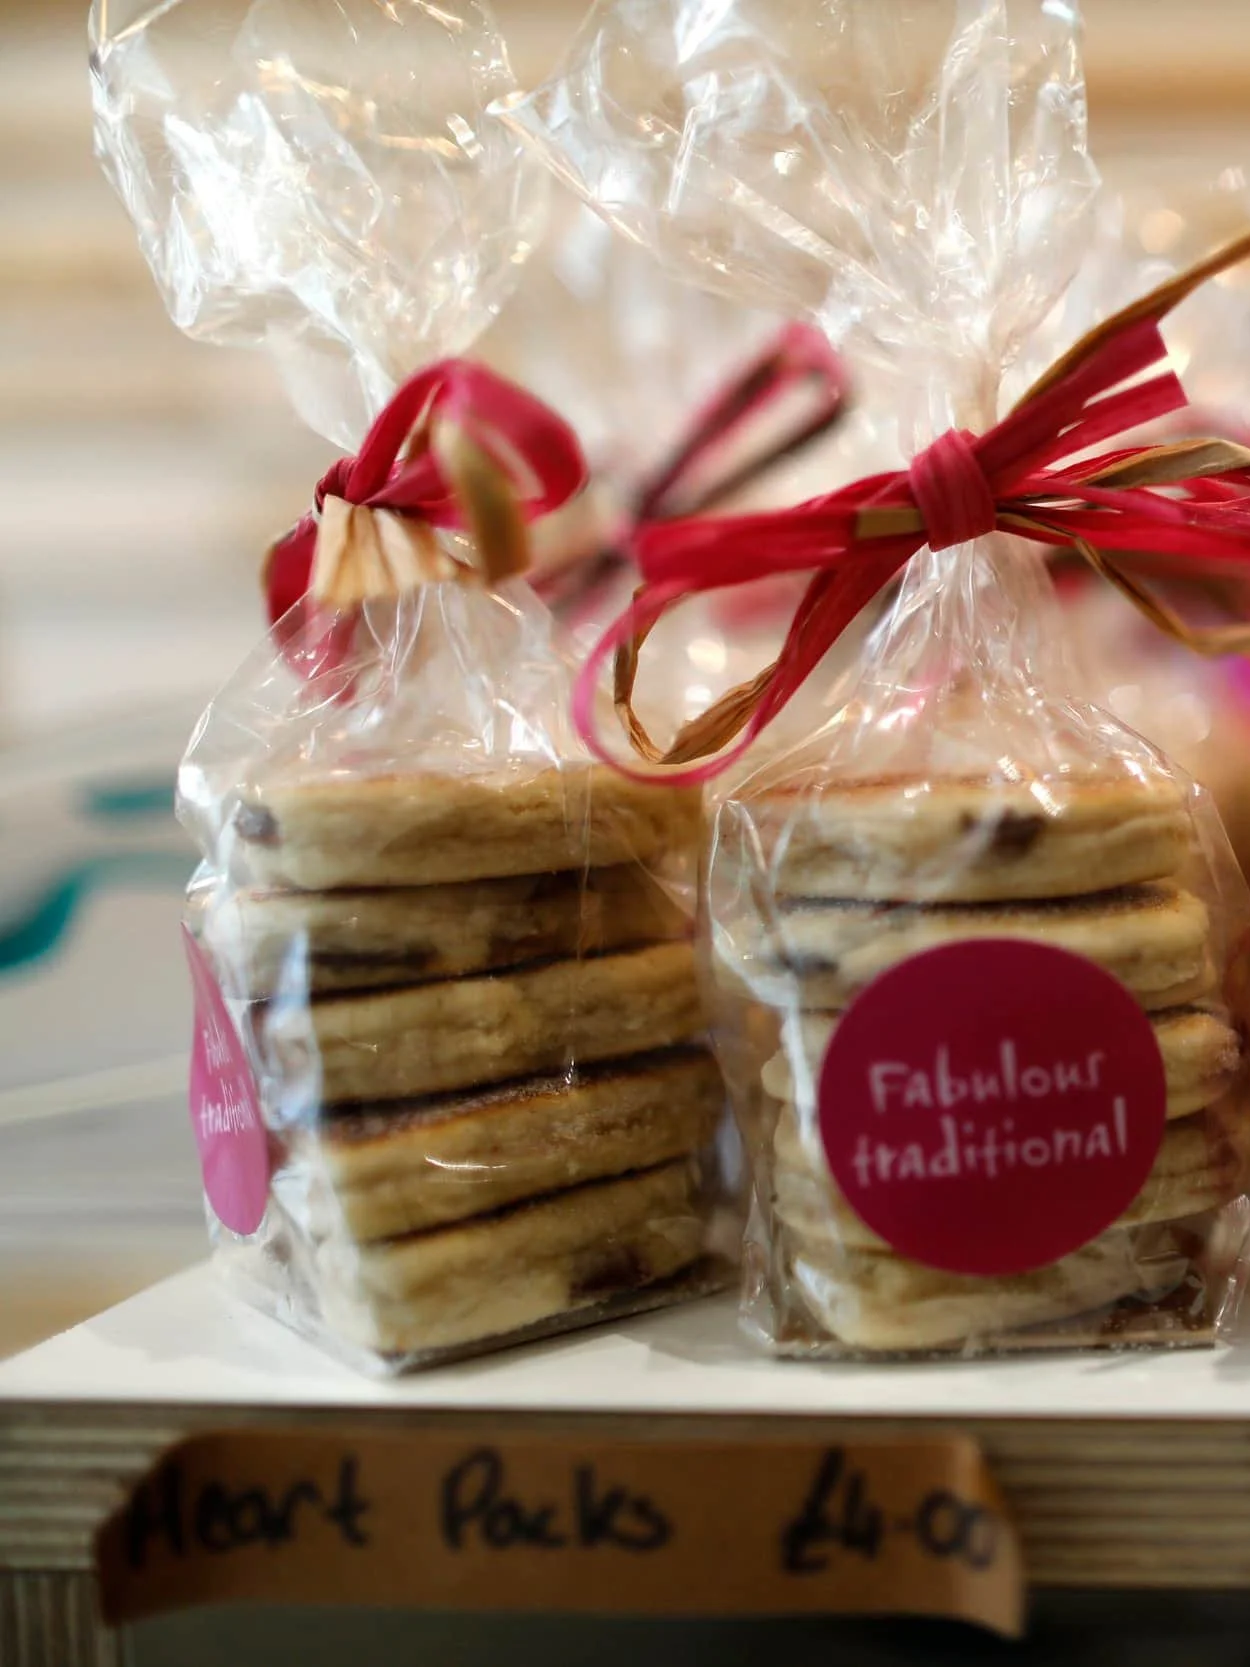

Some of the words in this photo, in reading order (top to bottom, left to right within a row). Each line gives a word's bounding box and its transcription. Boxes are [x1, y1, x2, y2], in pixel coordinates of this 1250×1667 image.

[868, 1037, 1105, 1116] Fabulous
[852, 1096, 1129, 1189] traditional
[124, 1450, 371, 1570] Heart
[438, 1446, 675, 1556] Packs
